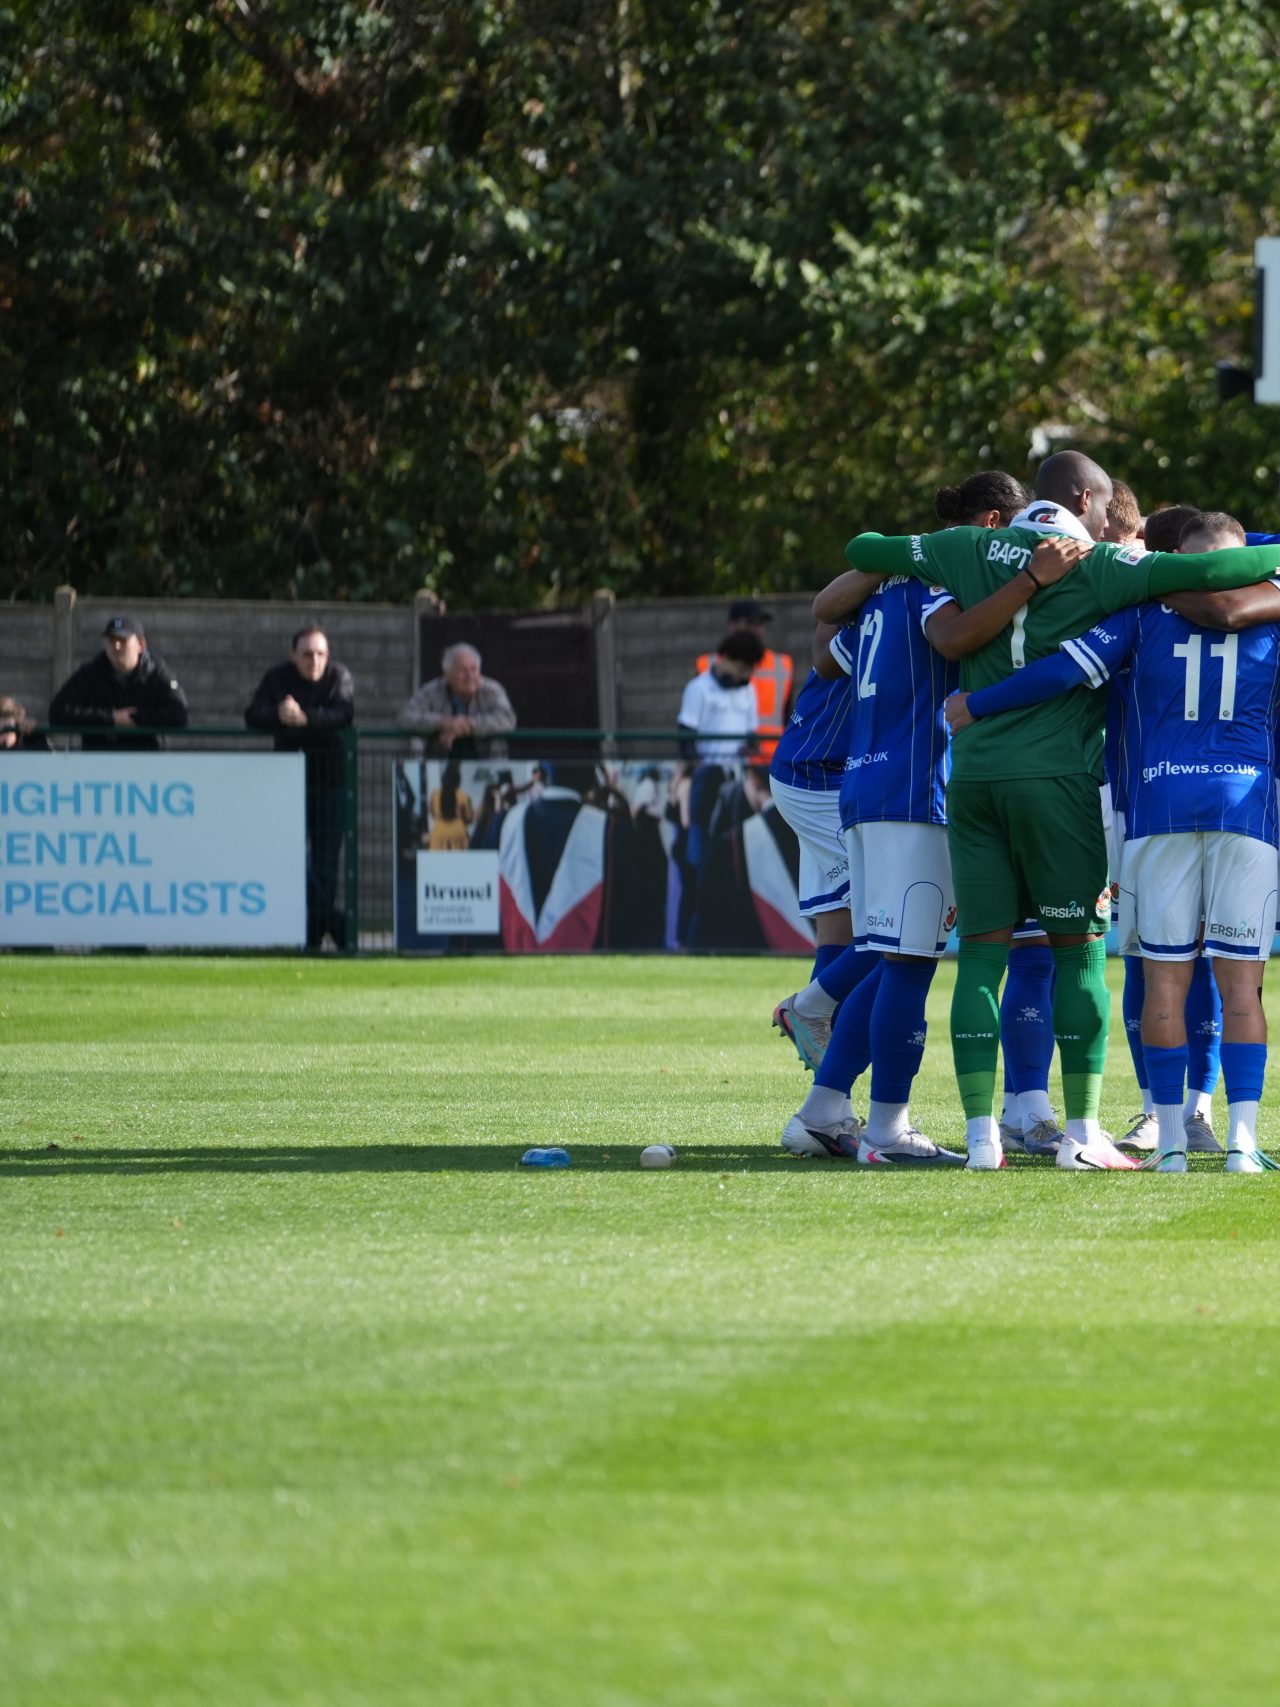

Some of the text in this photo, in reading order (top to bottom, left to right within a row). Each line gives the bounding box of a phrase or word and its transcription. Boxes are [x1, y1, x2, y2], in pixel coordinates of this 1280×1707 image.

[986, 540, 1032, 570] BAPT
[1173, 633, 1239, 721] 11
[0, 781, 195, 817] IGHTING
[0, 832, 152, 866] ENTAL
[0, 880, 266, 916] PECIALISTS
